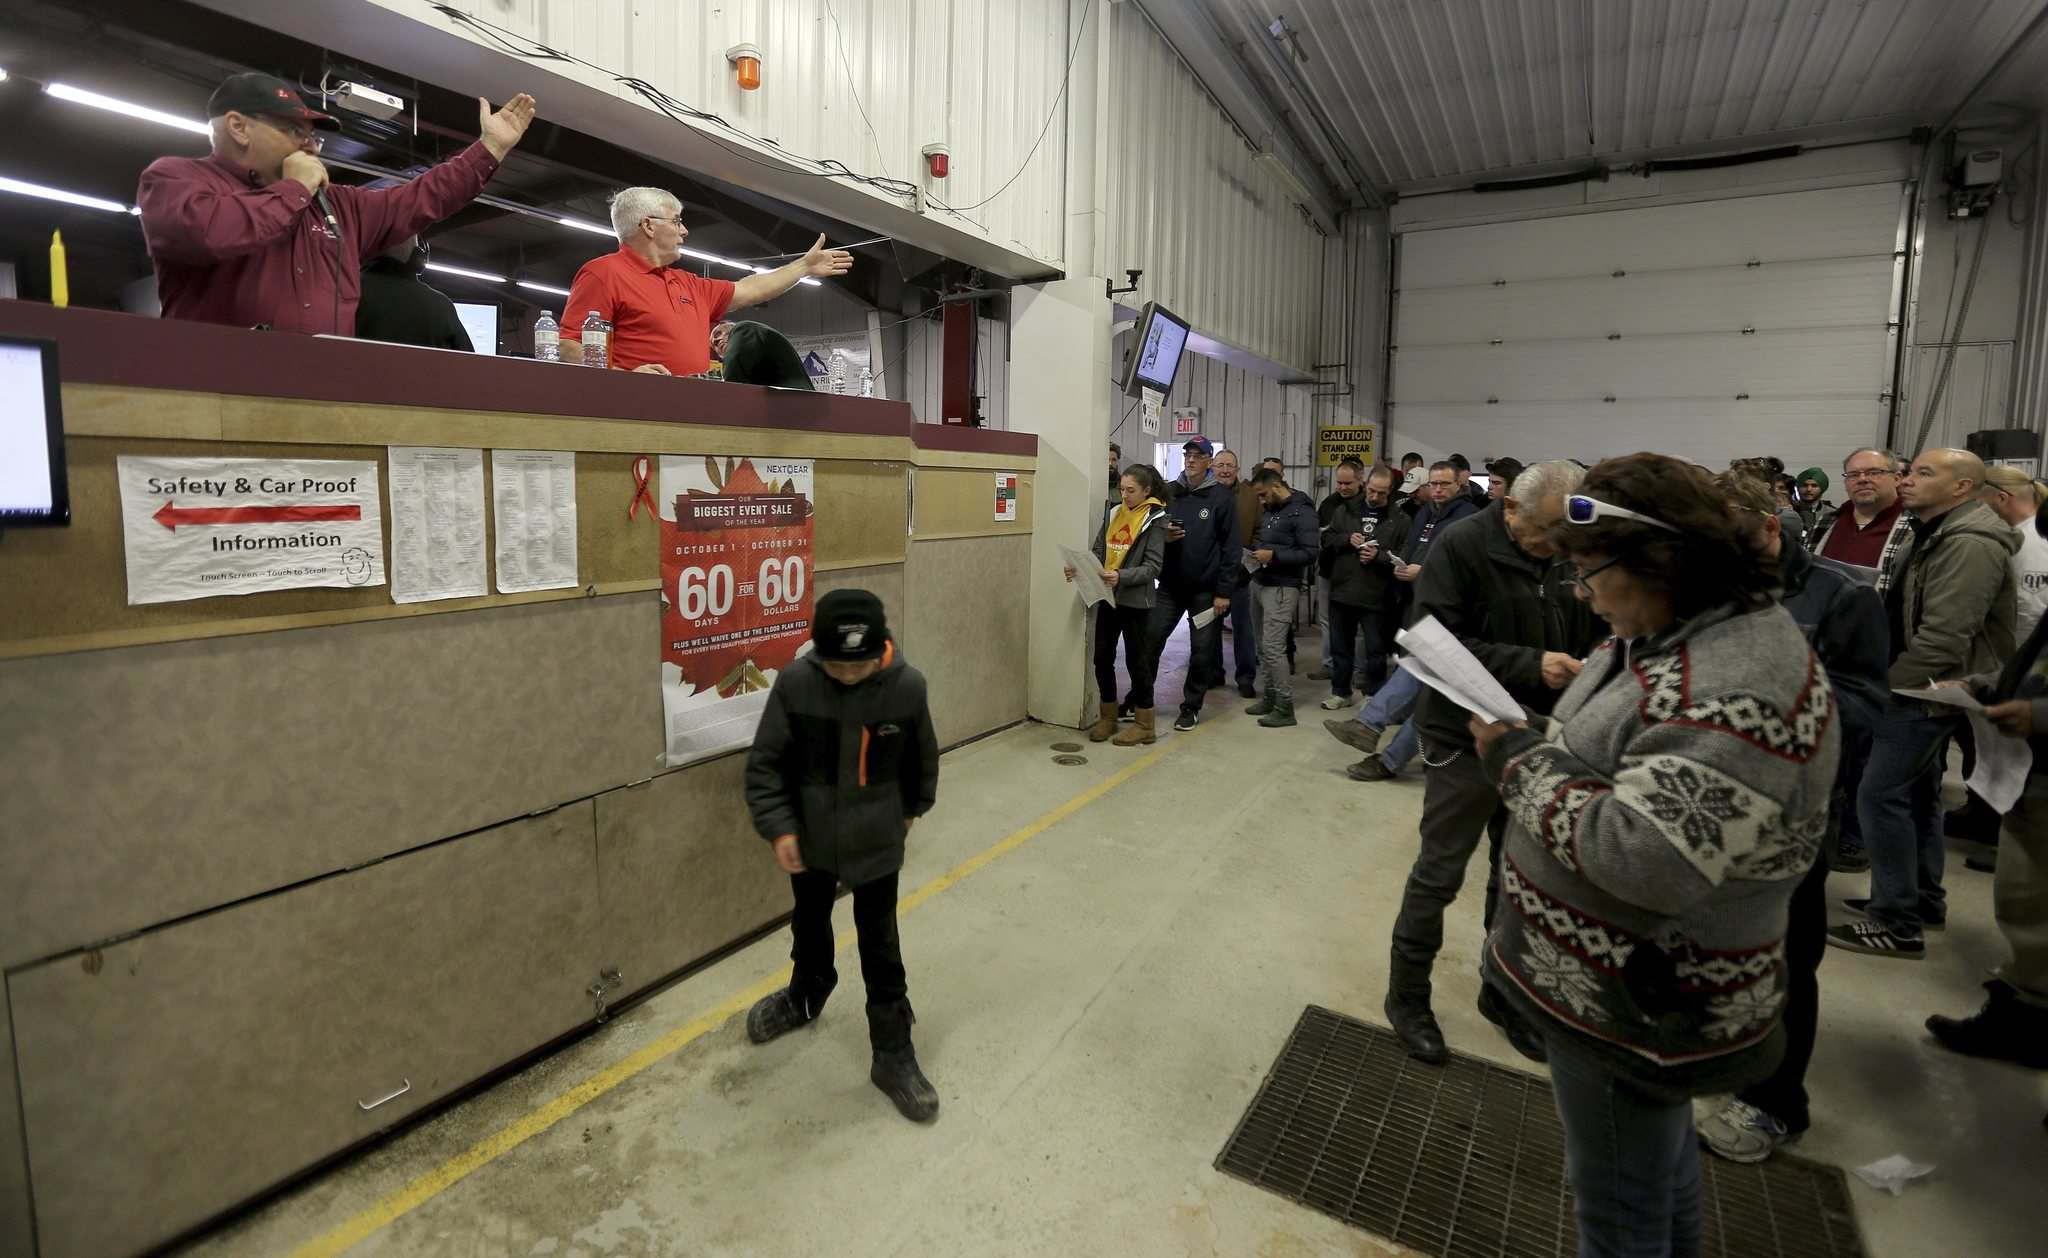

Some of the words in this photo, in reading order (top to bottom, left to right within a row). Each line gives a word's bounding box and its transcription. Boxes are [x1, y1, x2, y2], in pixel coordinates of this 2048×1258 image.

[1177, 418, 1194, 432] EXIT
[1322, 431, 1371, 440] CAUTION
[1322, 444, 1346, 453] STAND
[1347, 444, 1370, 452] CLEAR
[1330, 453, 1341, 462] OF
[766, 464, 808, 474] NEXTGEAR
[148, 476, 227, 497] Safety
[234, 477, 252, 494] &
[259, 477, 296, 493] Car
[302, 477, 357, 493] Proof
[694, 505, 735, 517] BIGGEST
[740, 504, 768, 516] EVENT
[771, 504, 792, 515] SALE
[212, 532, 342, 552] Information
[676, 543, 724, 555] OCTOBER
[751, 539, 792, 550] OCTOBER
[200, 573, 227, 583] Touch
[228, 571, 258, 580] Screen
[267, 568, 292, 577] Touch
[294, 568, 303, 576] to
[304, 567, 327, 575] Scroll
[678, 563, 734, 620] 60
[739, 584, 753, 595] FOR
[758, 555, 805, 607] 60
[763, 603, 799, 616] DOLLARS
[694, 616, 720, 628] DAYS
[673, 641, 690, 650] PLUS
[710, 635, 730, 643] WAIVE
[731, 632, 742, 640] ONE
[743, 629, 751, 637] OF
[752, 628, 762, 636] THE
[763, 625, 780, 634] FLOOR
[781, 622, 794, 631] PLAN
